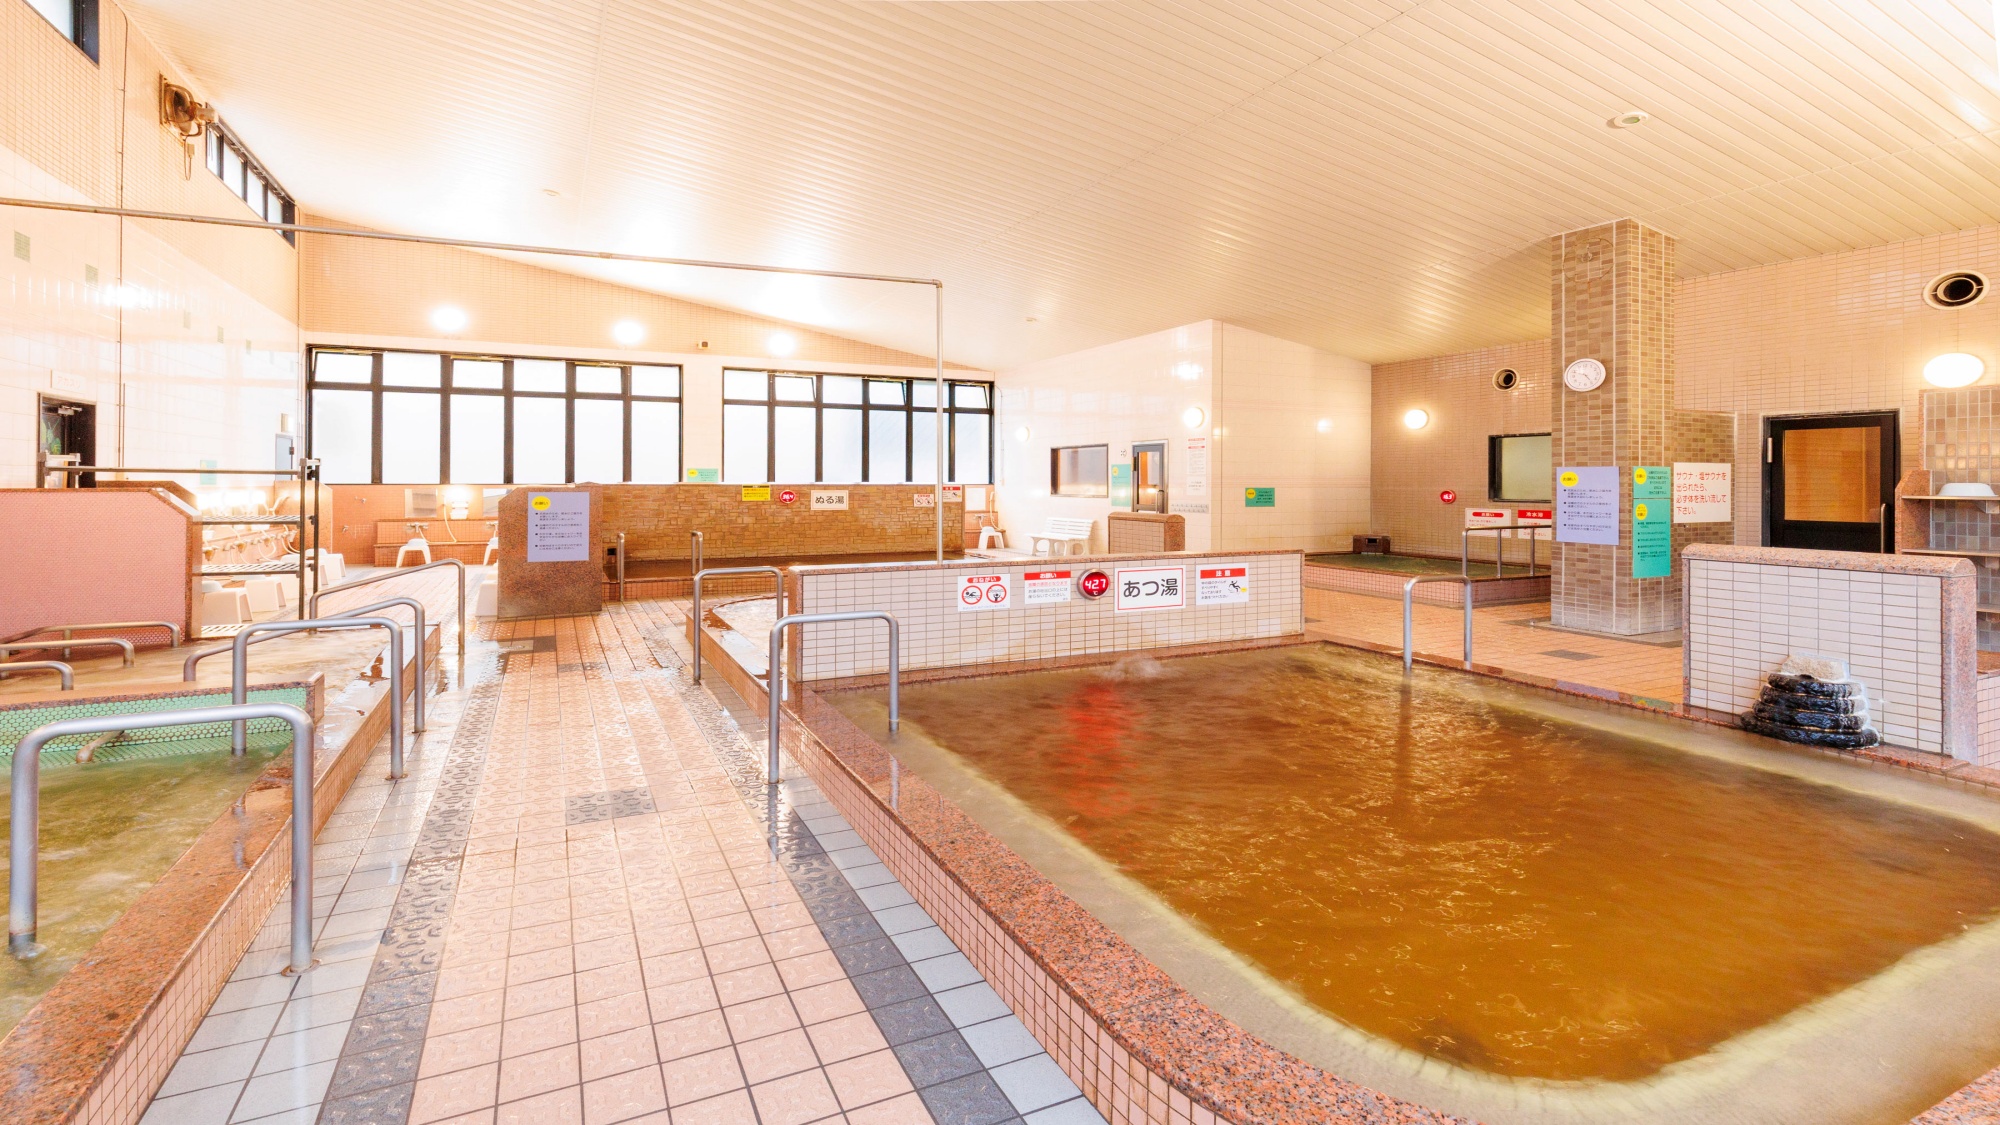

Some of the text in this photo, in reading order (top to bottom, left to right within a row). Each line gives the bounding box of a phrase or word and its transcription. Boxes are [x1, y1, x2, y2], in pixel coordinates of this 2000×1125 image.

[815, 495, 845, 504] ぬる湯
[1123, 578, 1179, 598] あつ湯
